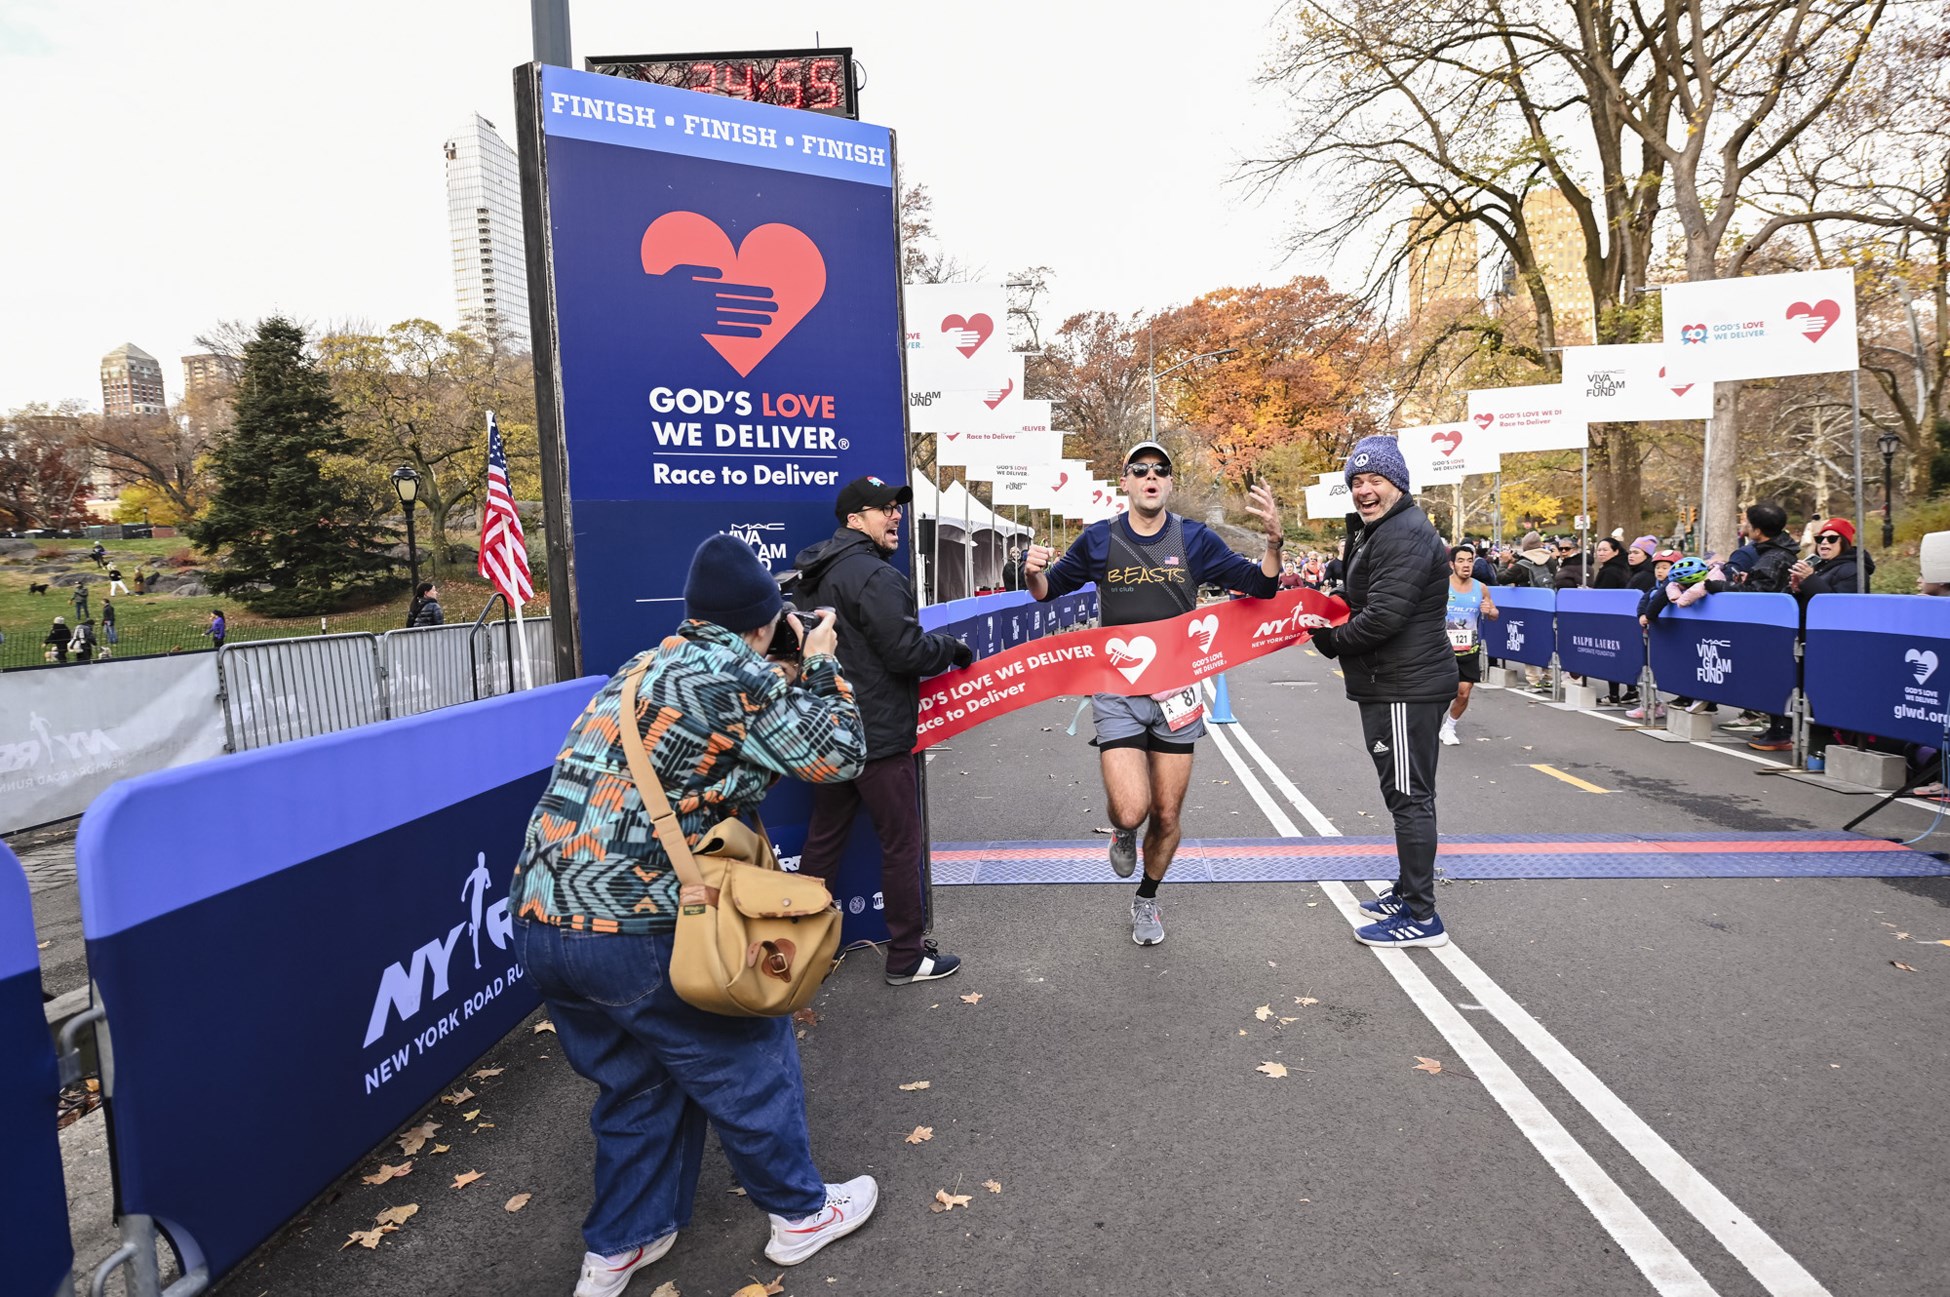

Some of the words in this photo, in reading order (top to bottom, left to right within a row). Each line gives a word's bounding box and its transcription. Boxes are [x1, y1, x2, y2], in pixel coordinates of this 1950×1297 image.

[552, 92, 656, 129] FINISH
[684, 114, 777, 149] FINISH
[802, 135, 885, 167] FINISH
[1713, 324, 1740, 332] GOD'S
[1743, 321, 1764, 329] LOVE
[1731, 330, 1764, 339] DELIVER
[1587, 374, 1611, 382] VIVA
[1594, 381, 1625, 389] GLAM
[1586, 389, 1616, 397] FUND
[650, 387, 752, 416] GOD'S
[762, 392, 836, 418] LOVE
[910, 398, 932, 406] UND
[652, 421, 702, 447] WE
[653, 463, 716, 484] Race
[722, 466, 747, 484] to
[754, 464, 838, 486] Deliver
[1108, 566, 1185, 584] BEASTS
[1456, 635, 1467, 643] 121
[1573, 636, 1592, 647] RALPH
[1595, 638, 1620, 650] LAUREN
[1702, 638, 1731, 647] MAC
[1696, 644, 1718, 659] VIVA
[1192, 657, 1209, 668] GOD'S
[1210, 652, 1223, 661] LOVE
[1703, 657, 1731, 673] GLAM
[950, 674, 994, 700] LOVE
[995, 661, 1025, 680] WE
[1027, 645, 1095, 669] DELIVER
[1697, 668, 1724, 684] FUND
[916, 715, 944, 734] ace
[946, 709, 965, 722] to
[966, 682, 1026, 713] Deliver
[364, 1044, 409, 1095] NEW
[414, 1008, 460, 1055] YORK
[464, 977, 503, 1020] ROAD
